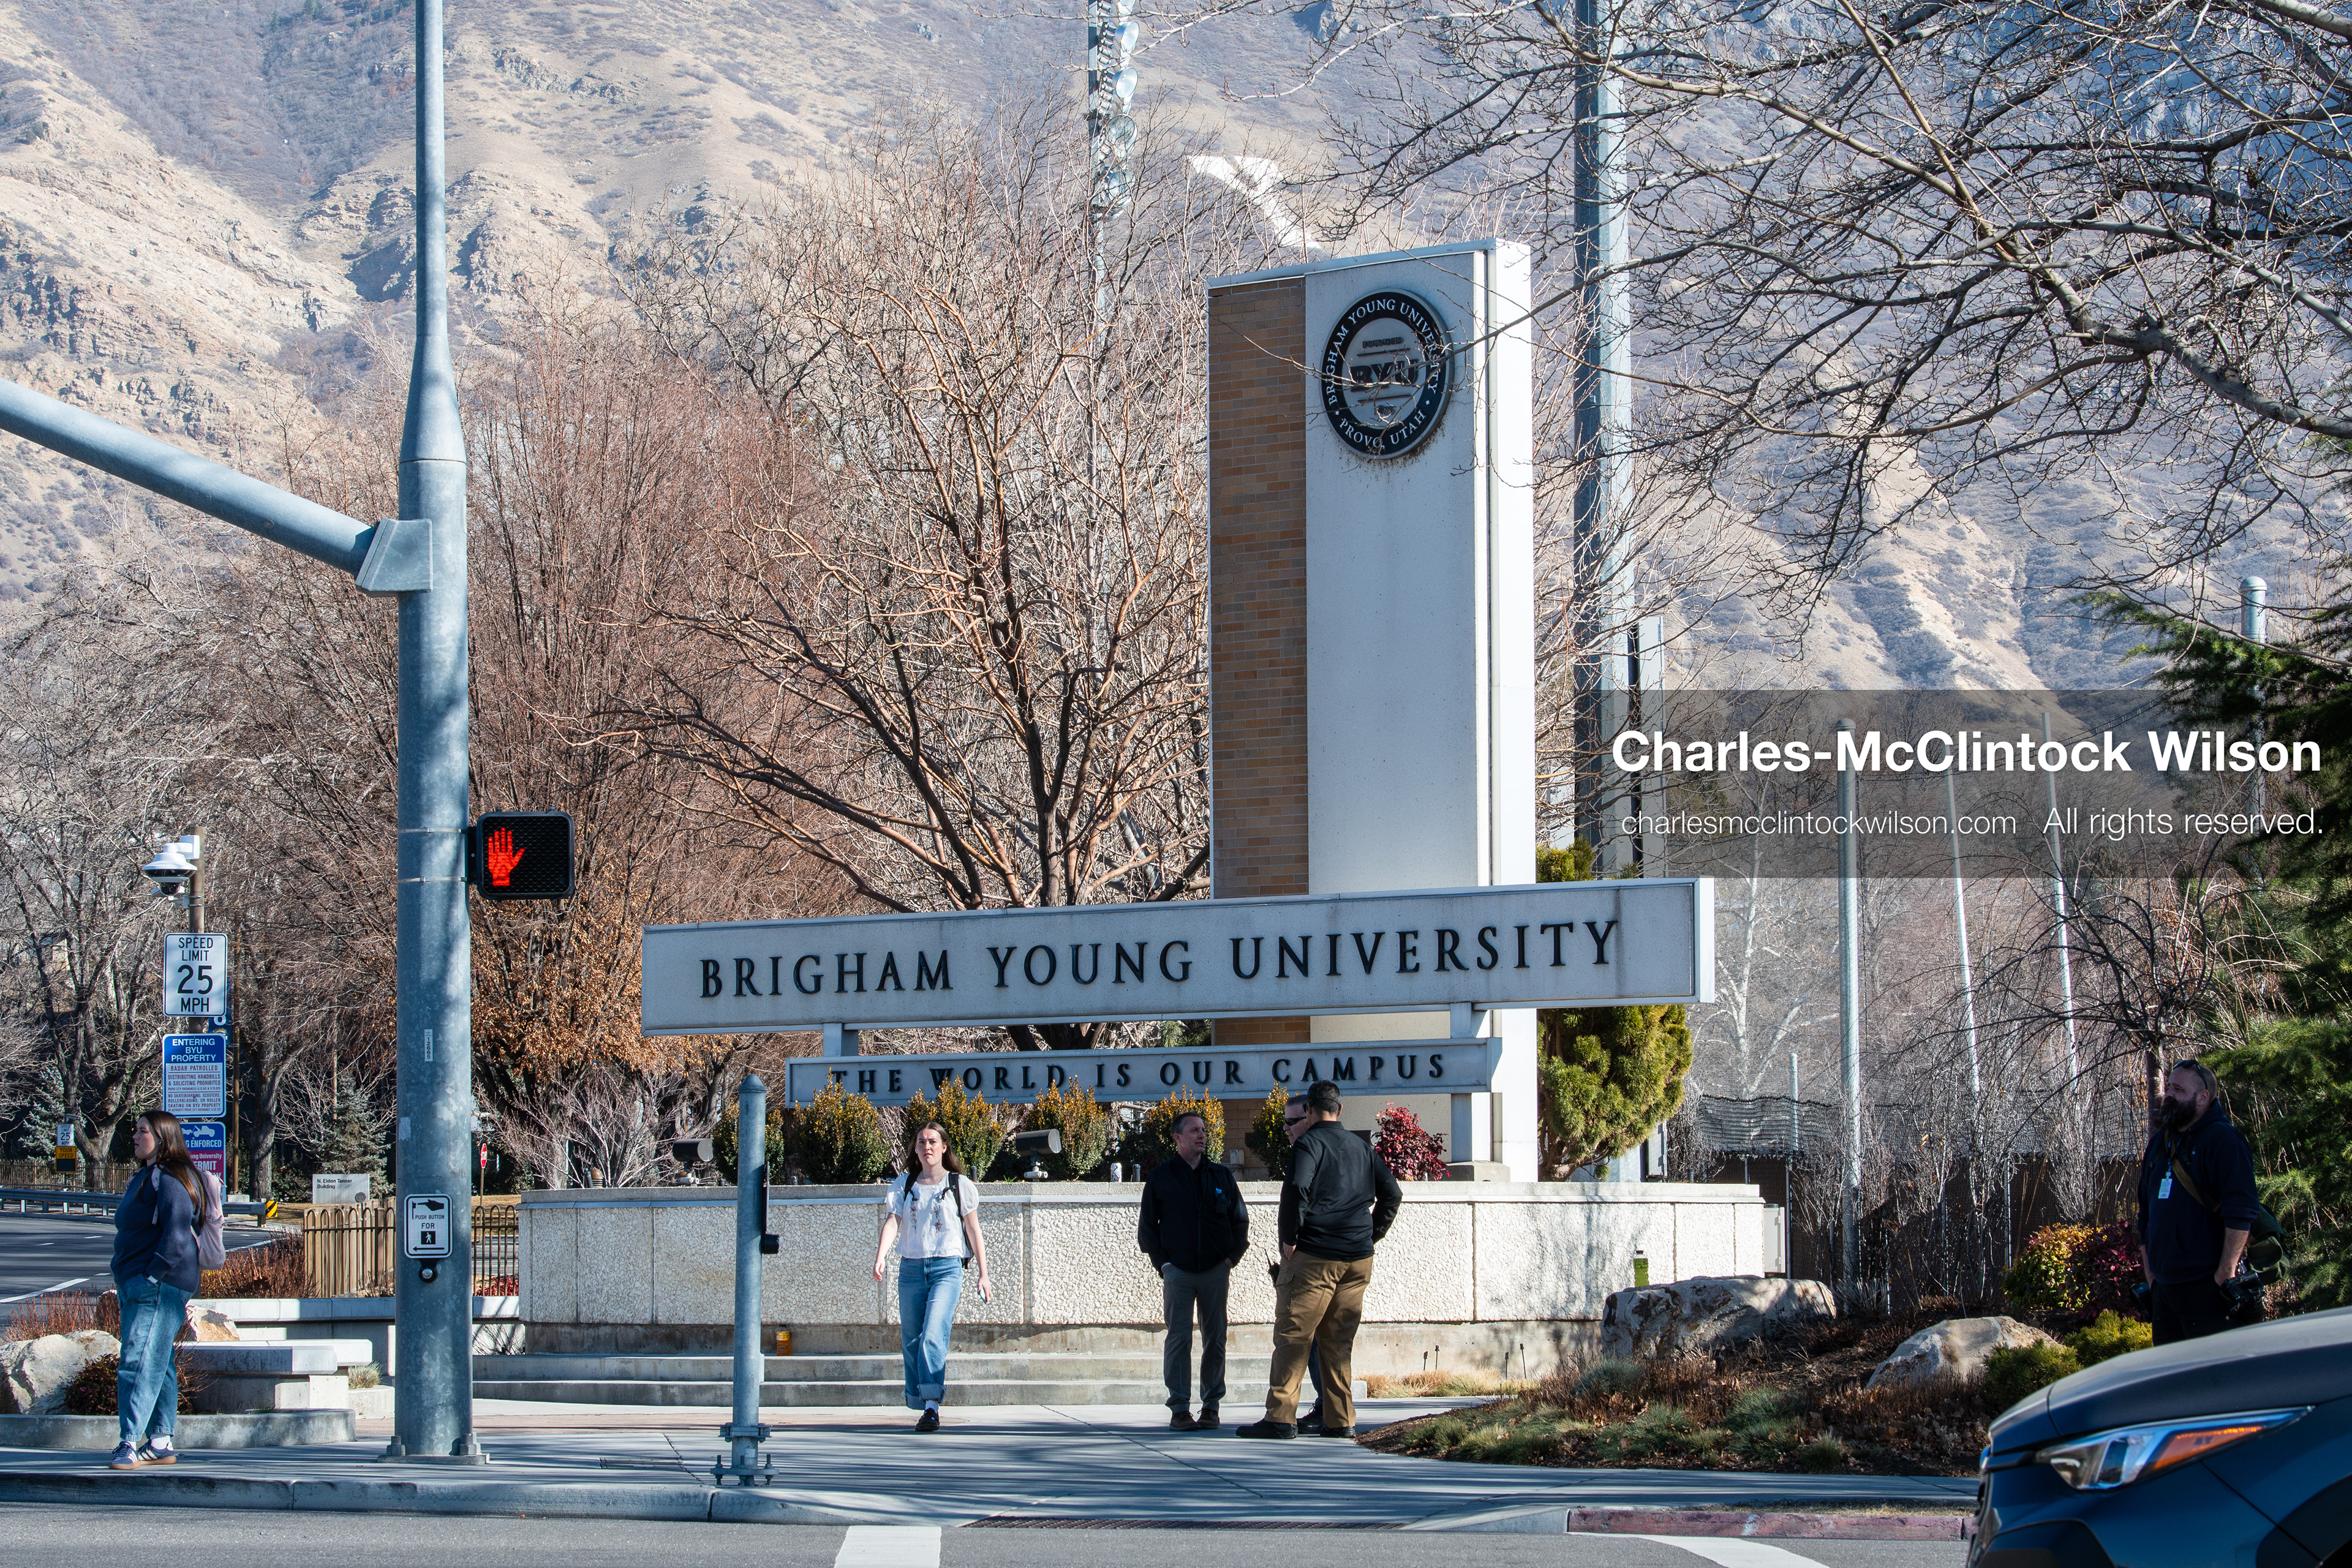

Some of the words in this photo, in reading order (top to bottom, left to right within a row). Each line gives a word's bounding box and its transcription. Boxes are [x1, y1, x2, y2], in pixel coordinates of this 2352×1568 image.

[1325, 324, 1349, 406] BRIGHAM
[1348, 299, 1396, 325] YOUNG
[1400, 302, 1439, 394] UNIVERSITY
[1362, 337, 1404, 349] FOUNDED
[1349, 359, 1419, 391] BYU
[1340, 418, 1385, 450] PROVO,
[1390, 409, 1426, 445] UTAH
[178, 937, 213, 949] SPEED
[182, 950, 209, 961] LIMIT
[699, 950, 954, 998] BRIGHAM
[986, 941, 1193, 989] YOUNG
[1229, 920, 1618, 980] UNIVERSITY
[178, 964, 213, 995] 25
[181, 997, 209, 1012] MPH
[831, 1069, 903, 1094] THE
[929, 1065, 1066, 1093] WORLD
[1095, 1063, 1131, 1089] IS
[1159, 1060, 1245, 1087] OUR
[1272, 1054, 1444, 1084] CAMPUS
[61, 1132, 70, 1140] 25
[190, 1139, 222, 1148] ENFORCED
